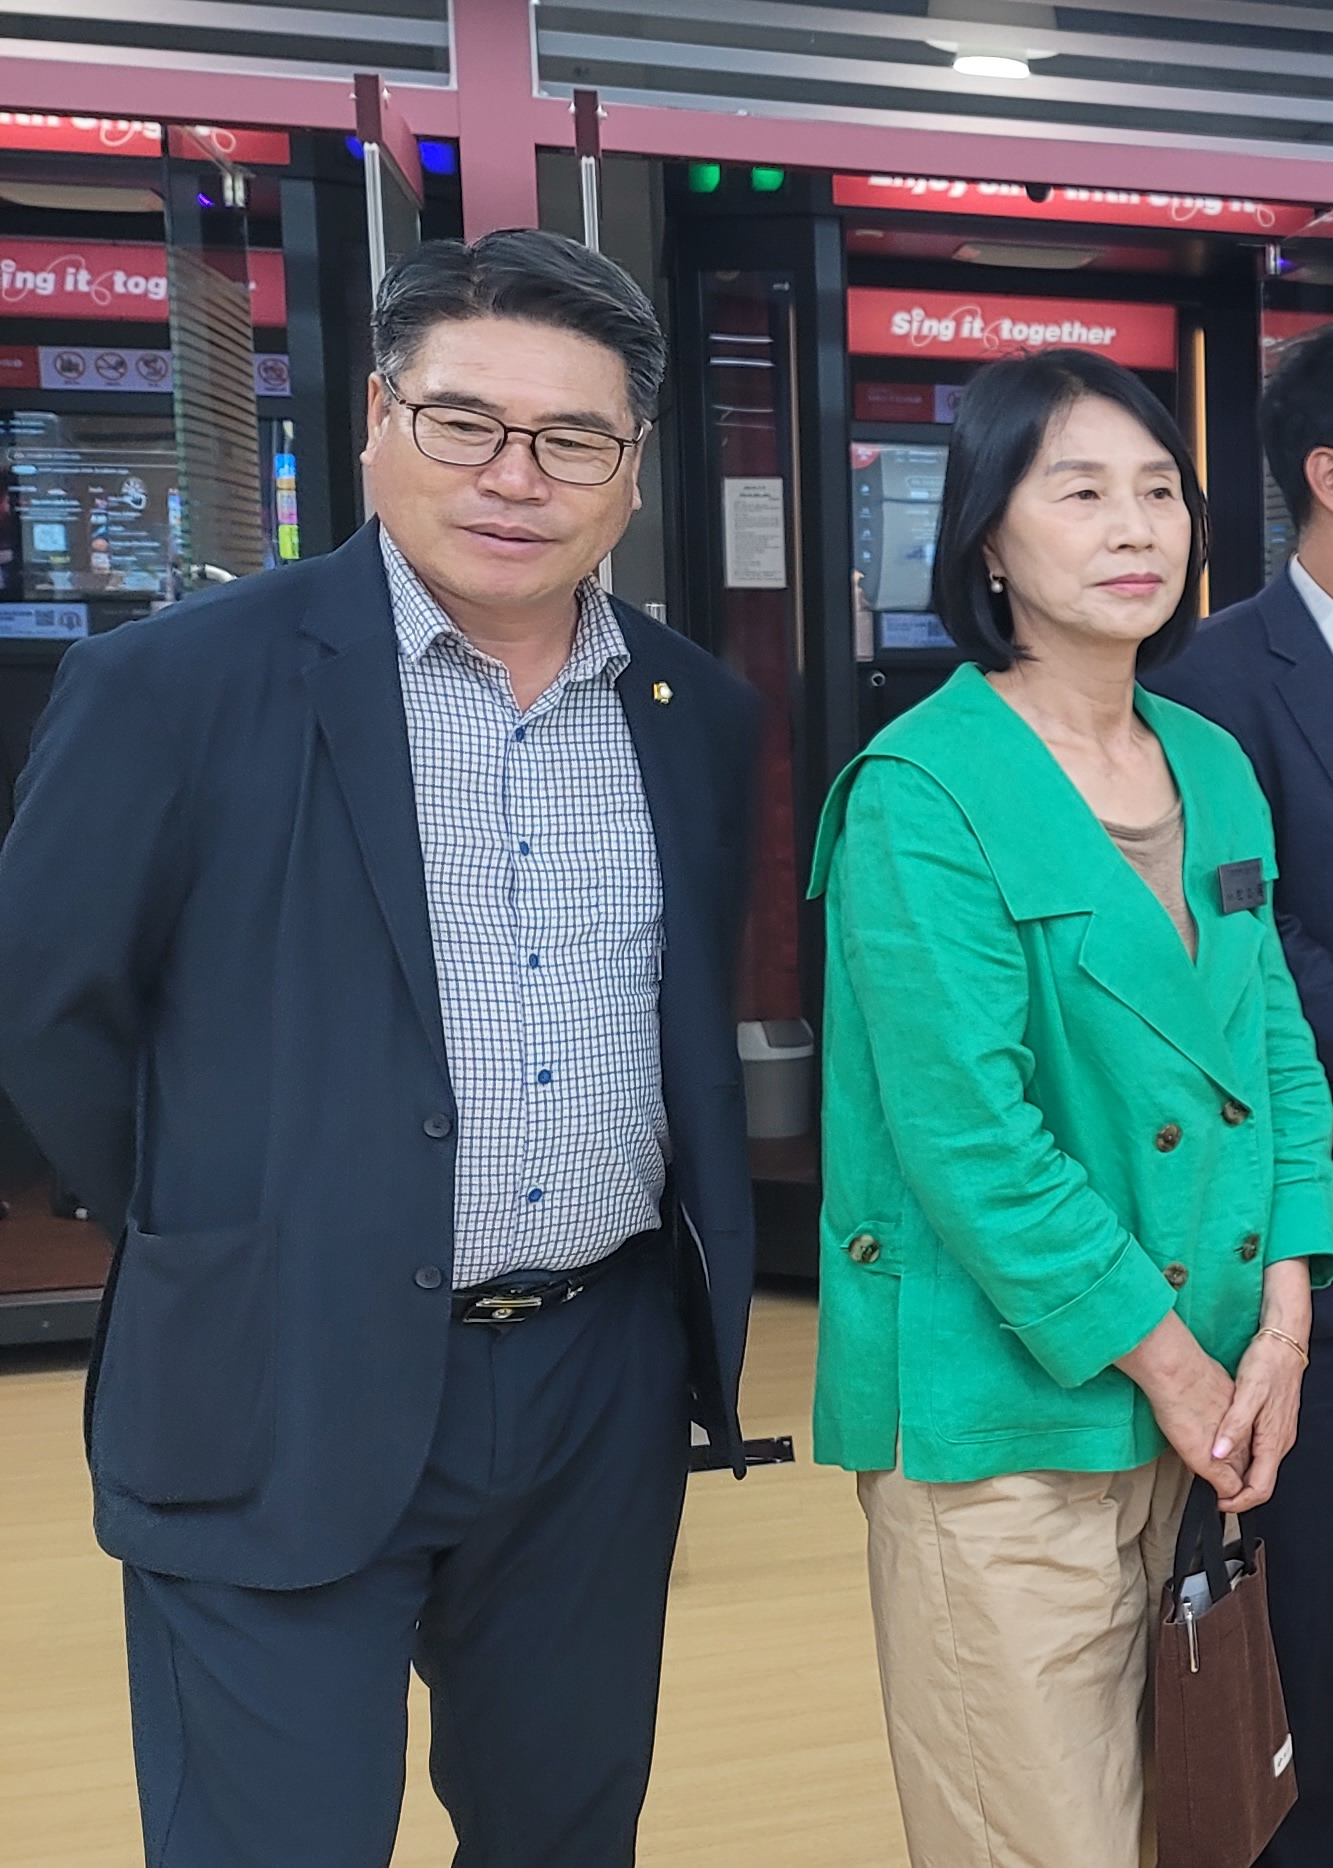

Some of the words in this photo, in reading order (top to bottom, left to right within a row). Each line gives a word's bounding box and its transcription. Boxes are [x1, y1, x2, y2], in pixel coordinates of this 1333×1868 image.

[0, 258, 56, 297] ing
[64, 267, 92, 293] it
[891, 307, 956, 344] Sing
[960, 312, 985, 339] it
[1000, 316, 1117, 346] together
